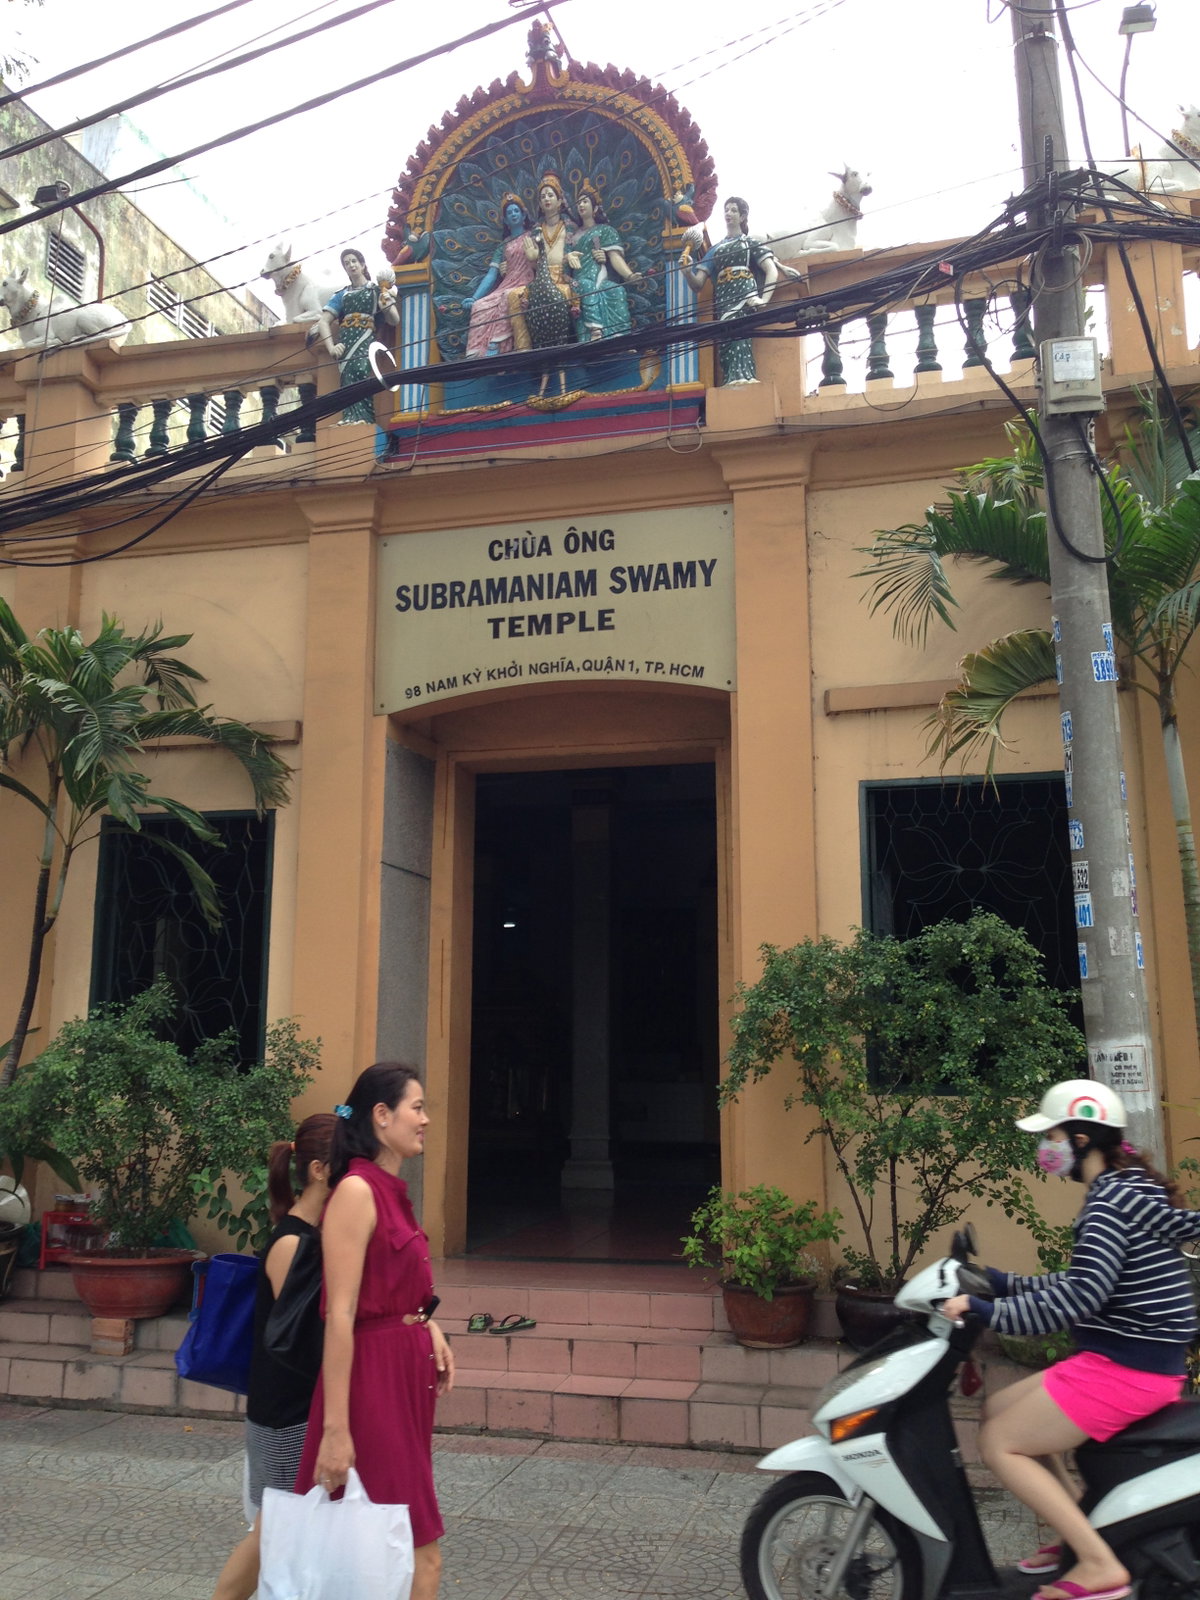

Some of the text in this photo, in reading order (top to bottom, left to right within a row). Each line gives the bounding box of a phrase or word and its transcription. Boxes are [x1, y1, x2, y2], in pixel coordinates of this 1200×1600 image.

[488, 526, 615, 561] CHÙA ÔNG
[395, 558, 717, 612] SUBRAMANIAM SWAMY
[487, 608, 615, 639] TEMPLE
[405, 685, 421, 699] 98
[426, 676, 458, 694] NAM
[462, 668, 482, 686] KỲ
[487, 660, 523, 681] KHỞI
[582, 656, 626, 674] QUẬN
[669, 663, 705, 678] HCM
